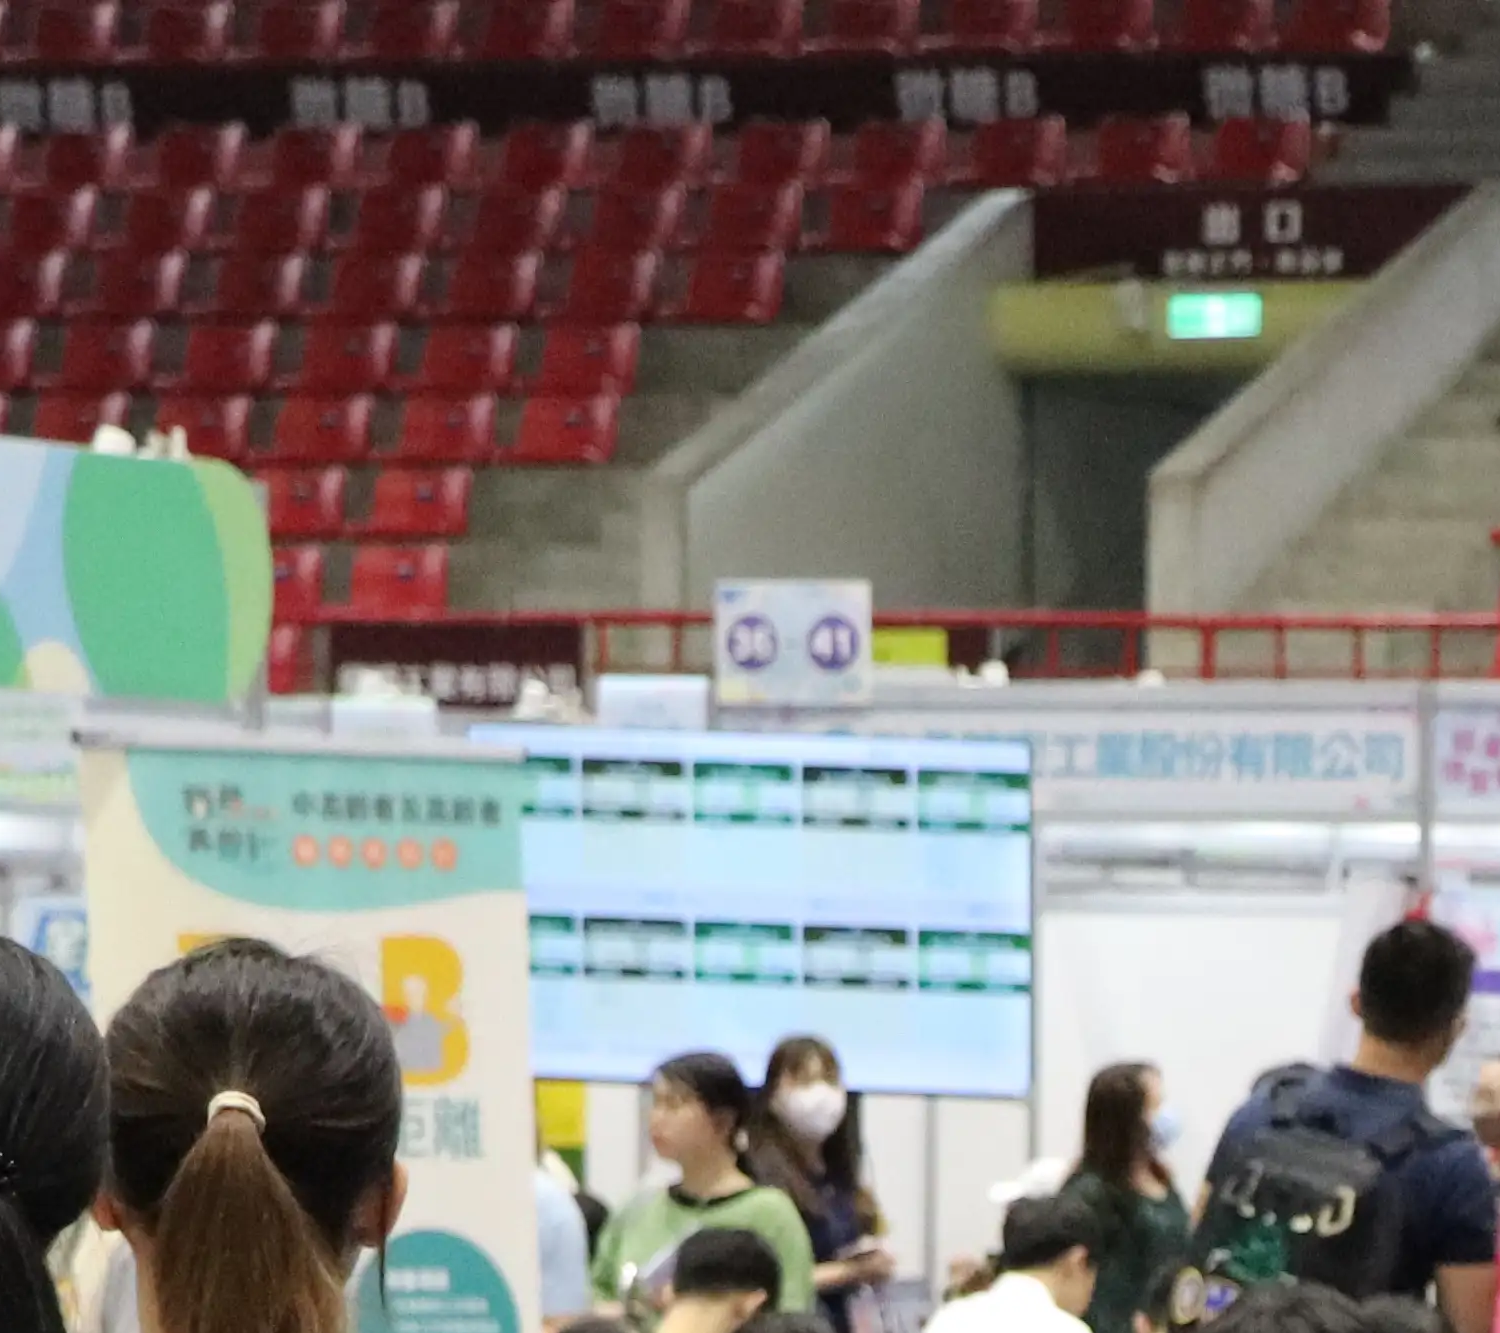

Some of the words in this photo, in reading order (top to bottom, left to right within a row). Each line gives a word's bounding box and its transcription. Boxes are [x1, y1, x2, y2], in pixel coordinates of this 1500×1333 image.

[1034, 730, 1406, 781] 工業股份有限公司
